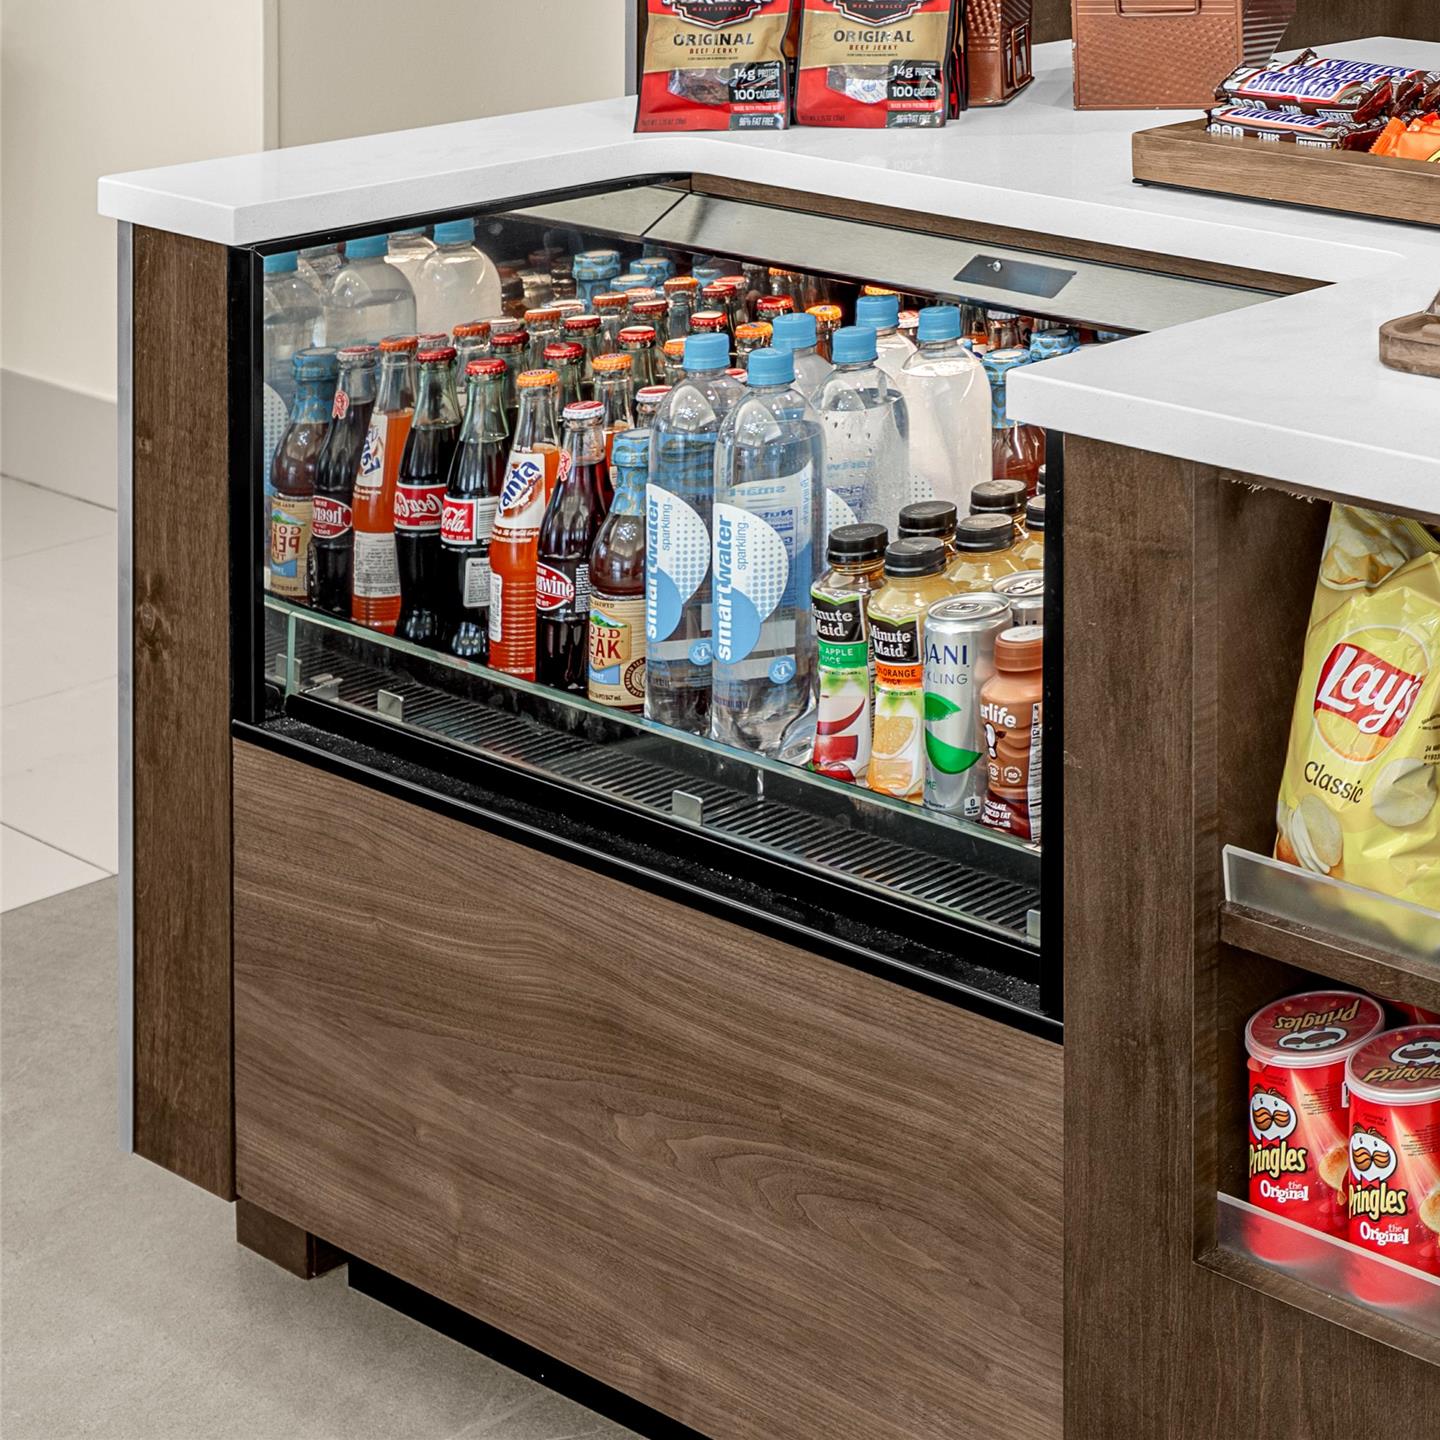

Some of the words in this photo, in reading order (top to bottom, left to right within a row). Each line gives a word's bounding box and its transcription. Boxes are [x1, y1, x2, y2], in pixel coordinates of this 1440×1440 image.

[674, 34, 754, 46] ORIGINAL
[734, 68, 755, 80] 14g
[1250, 72, 1344, 97] SNICKERS
[736, 521, 747, 570] sparkling
[719, 515, 731, 661] smartwater
[825, 648, 853, 656] APPLE
[882, 669, 916, 677] ORANGE
[1318, 646, 1421, 733] Lay's
[1305, 762, 1363, 803] Classic
[1261, 1180, 1308, 1202] Original
